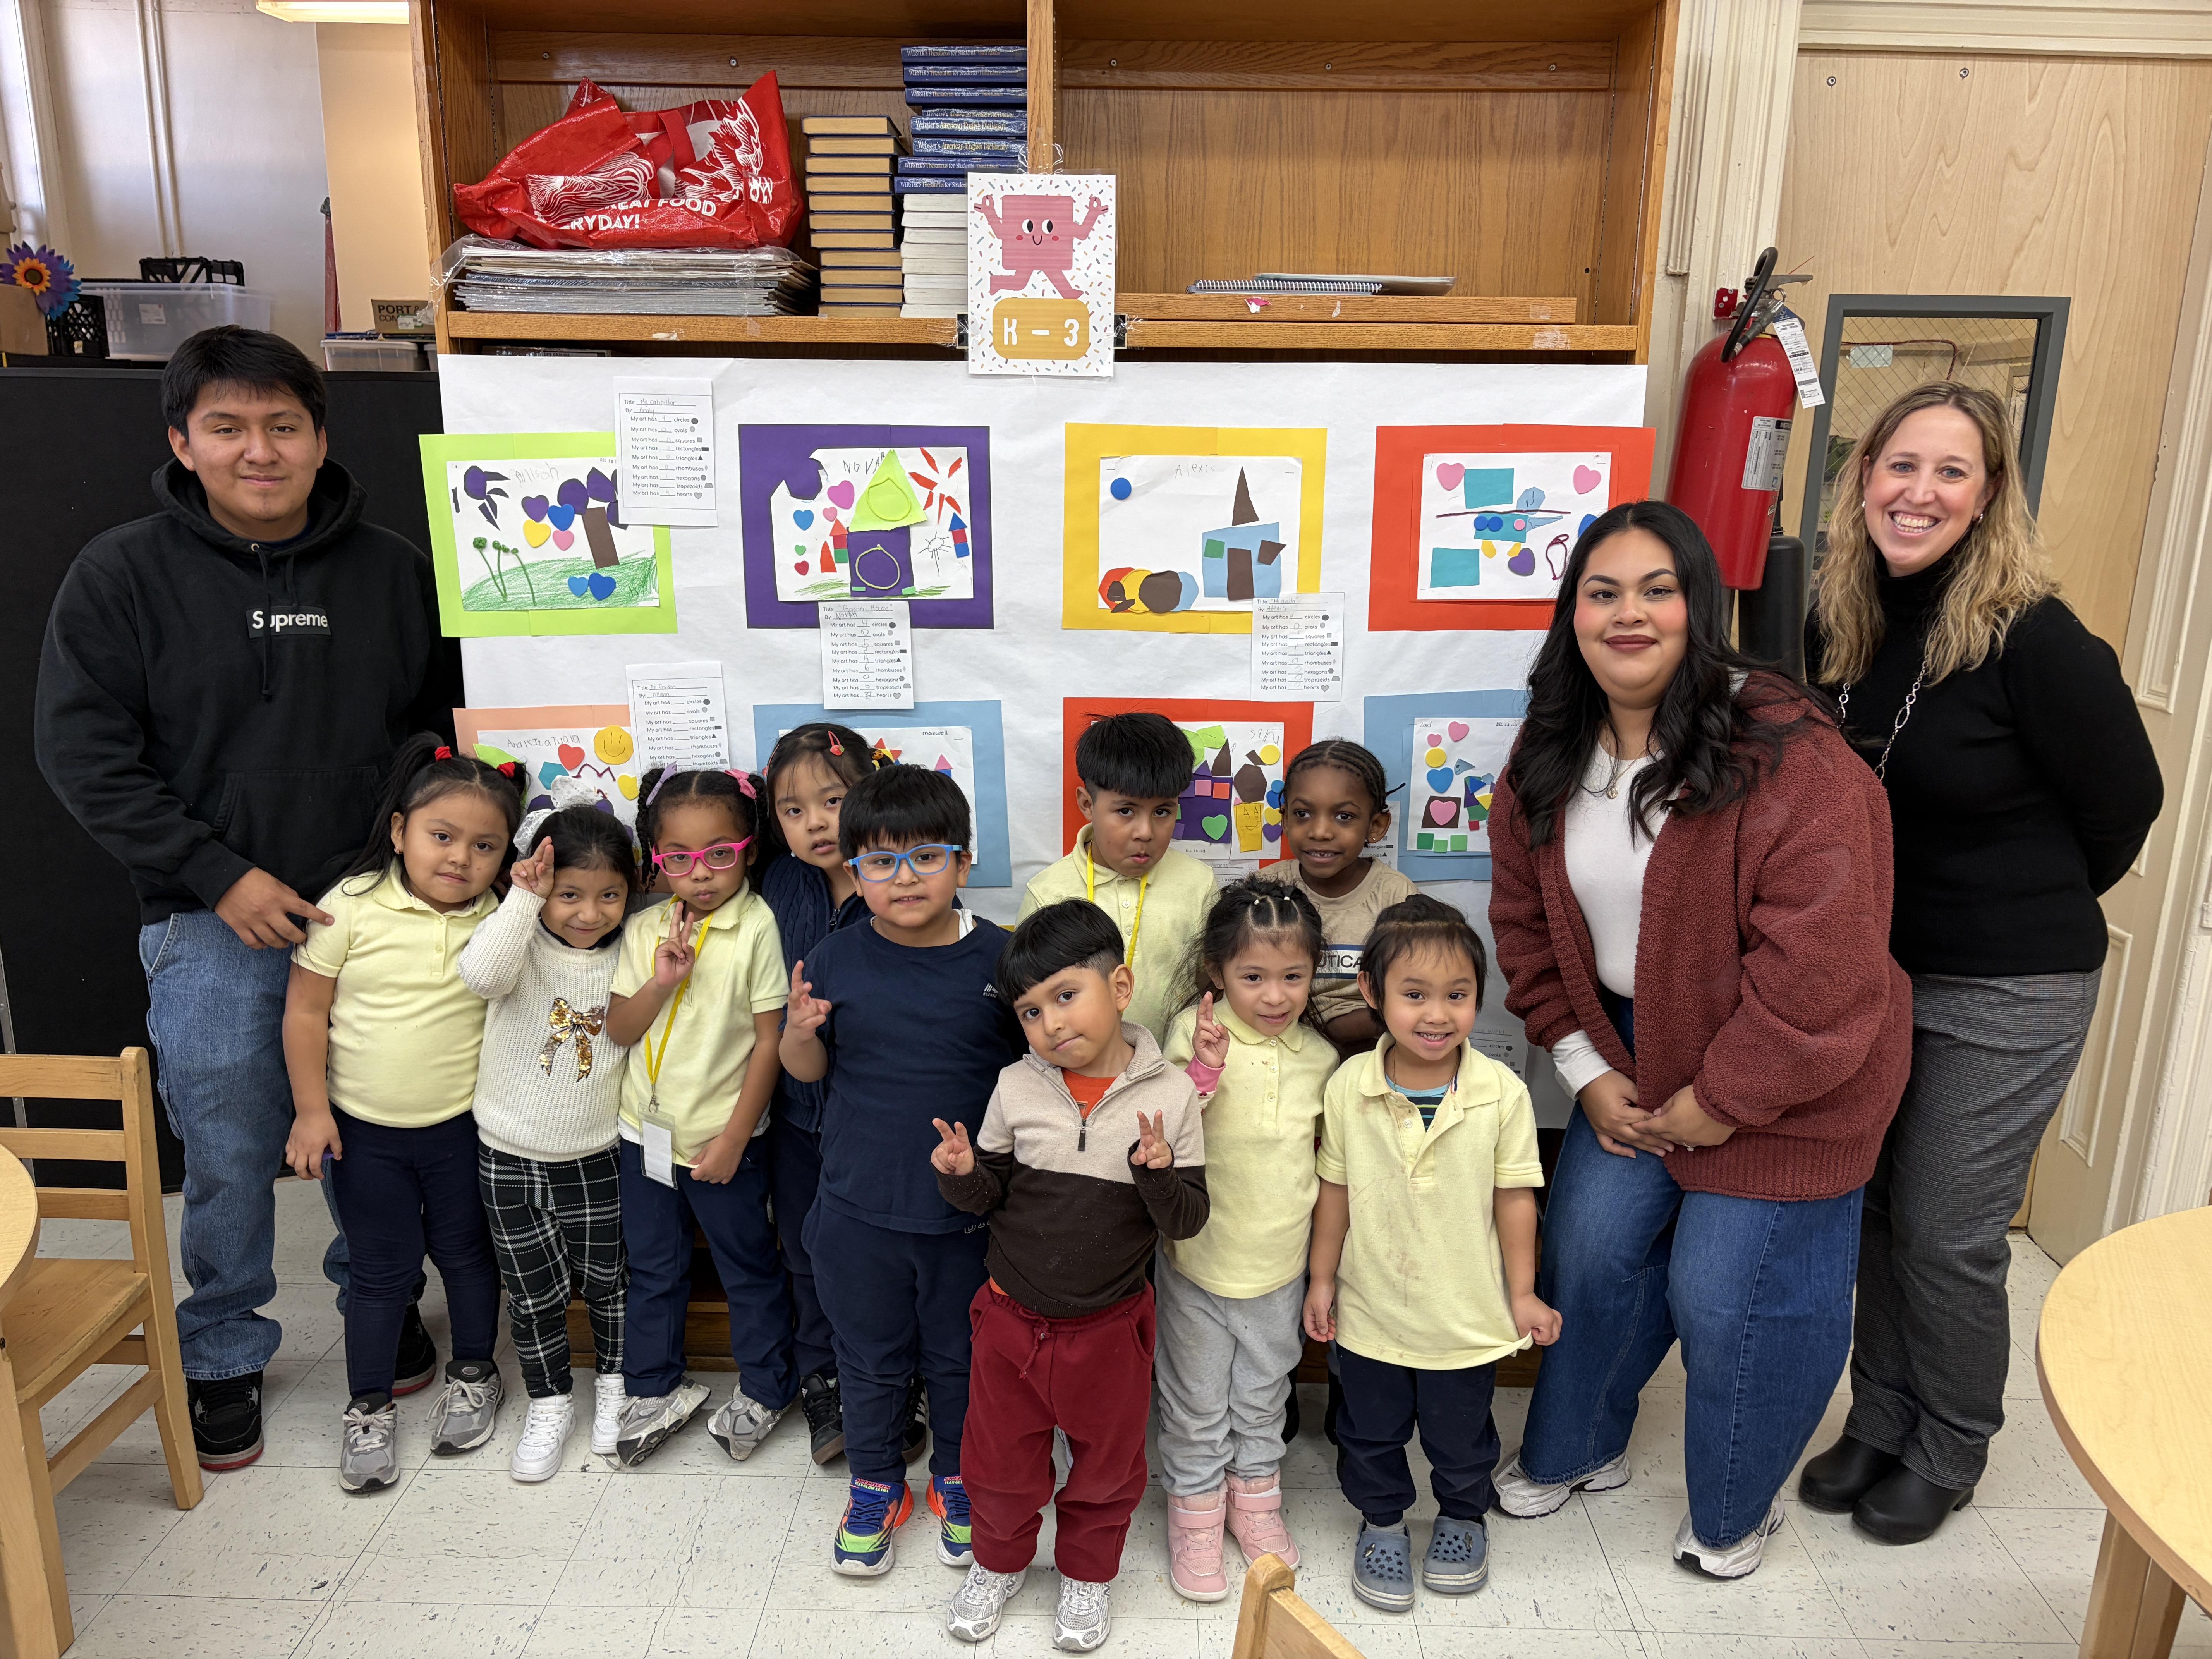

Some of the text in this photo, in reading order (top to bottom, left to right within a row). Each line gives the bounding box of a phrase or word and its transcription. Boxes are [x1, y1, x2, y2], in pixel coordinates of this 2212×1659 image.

[915, 120, 939, 128] Webster's
[939, 121, 962, 129] American
[963, 122, 981, 130] English
[917, 141, 1009, 151] Webster's American English Dictionary
[658, 198, 716, 216] FOOD
[378, 305, 411, 314] PORT
[1003, 318, 1017, 345] K
[1063, 318, 1079, 347] 3
[1175, 463, 1215, 478] Alexis
